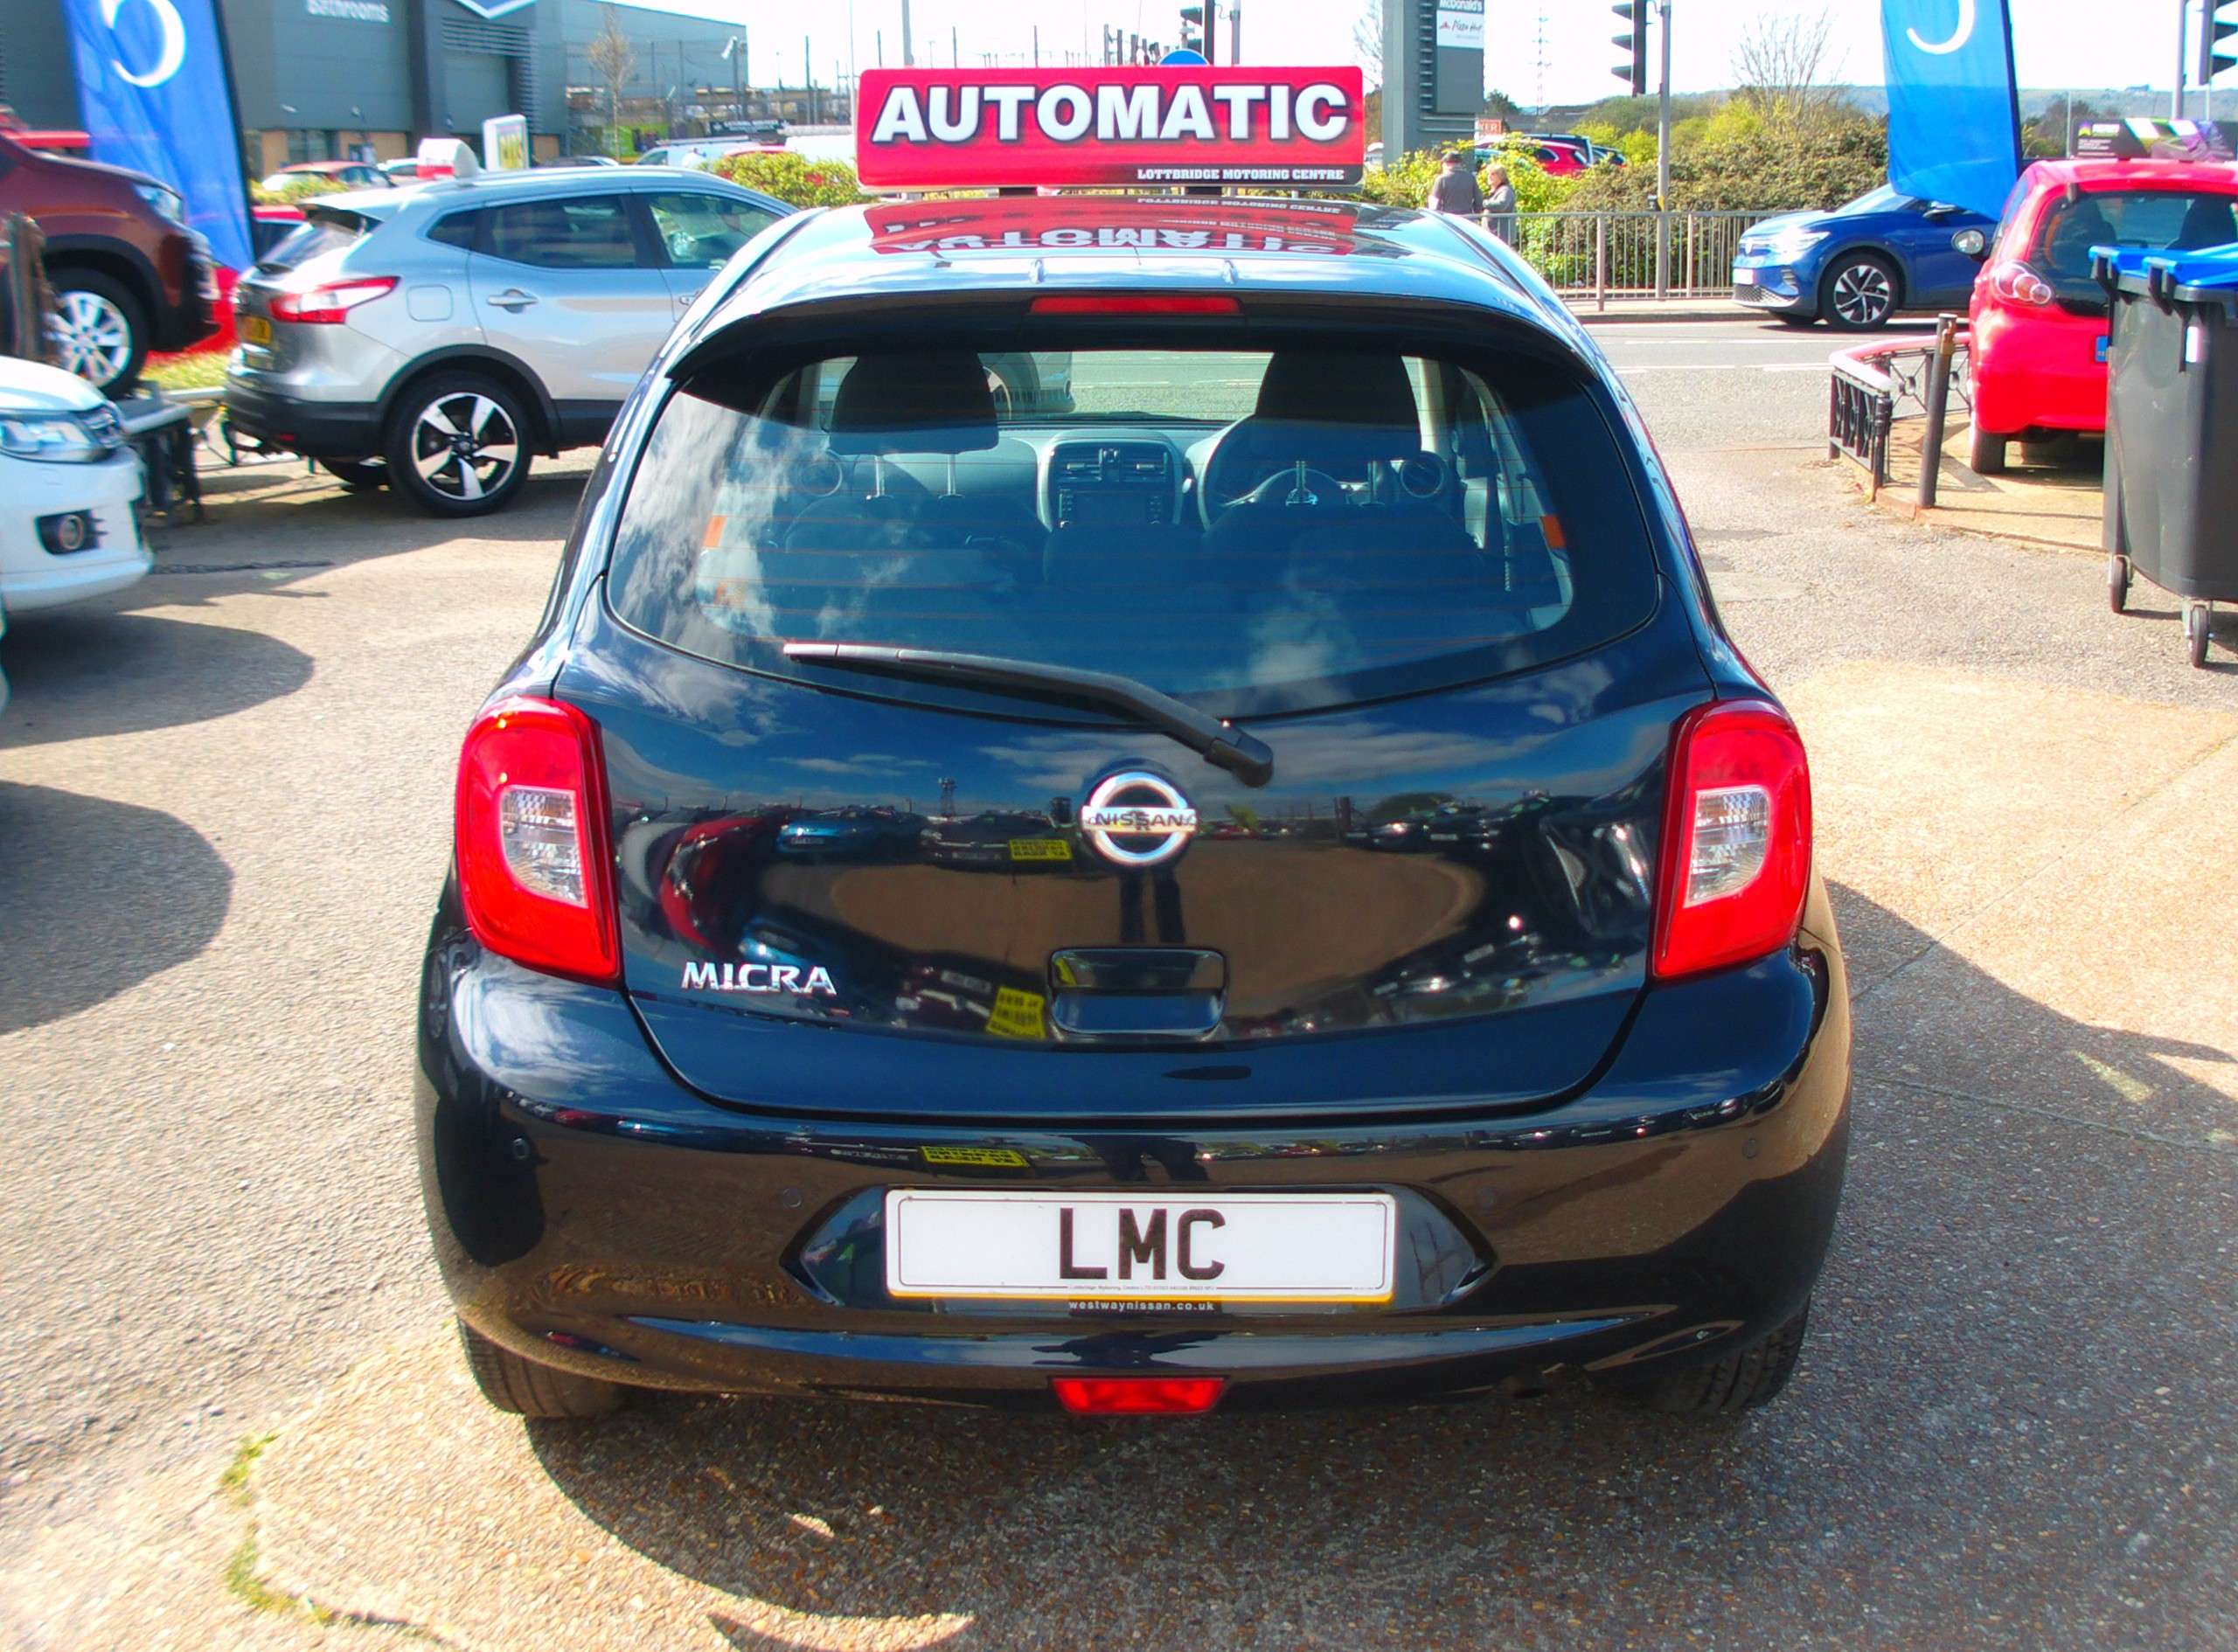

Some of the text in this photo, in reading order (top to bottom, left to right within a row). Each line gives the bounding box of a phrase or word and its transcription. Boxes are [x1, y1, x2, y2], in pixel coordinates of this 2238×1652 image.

[872, 83, 1348, 142] AUTOMATIC
[1137, 169, 1345, 180] LOTTBRIDGE MOTORING CENTRE
[1095, 812, 1184, 827] NISSAN
[682, 961, 838, 996] MICRA
[1059, 1207, 1227, 1281] LMC
[1068, 1301, 1214, 1312] westwaynissan.co.uk
